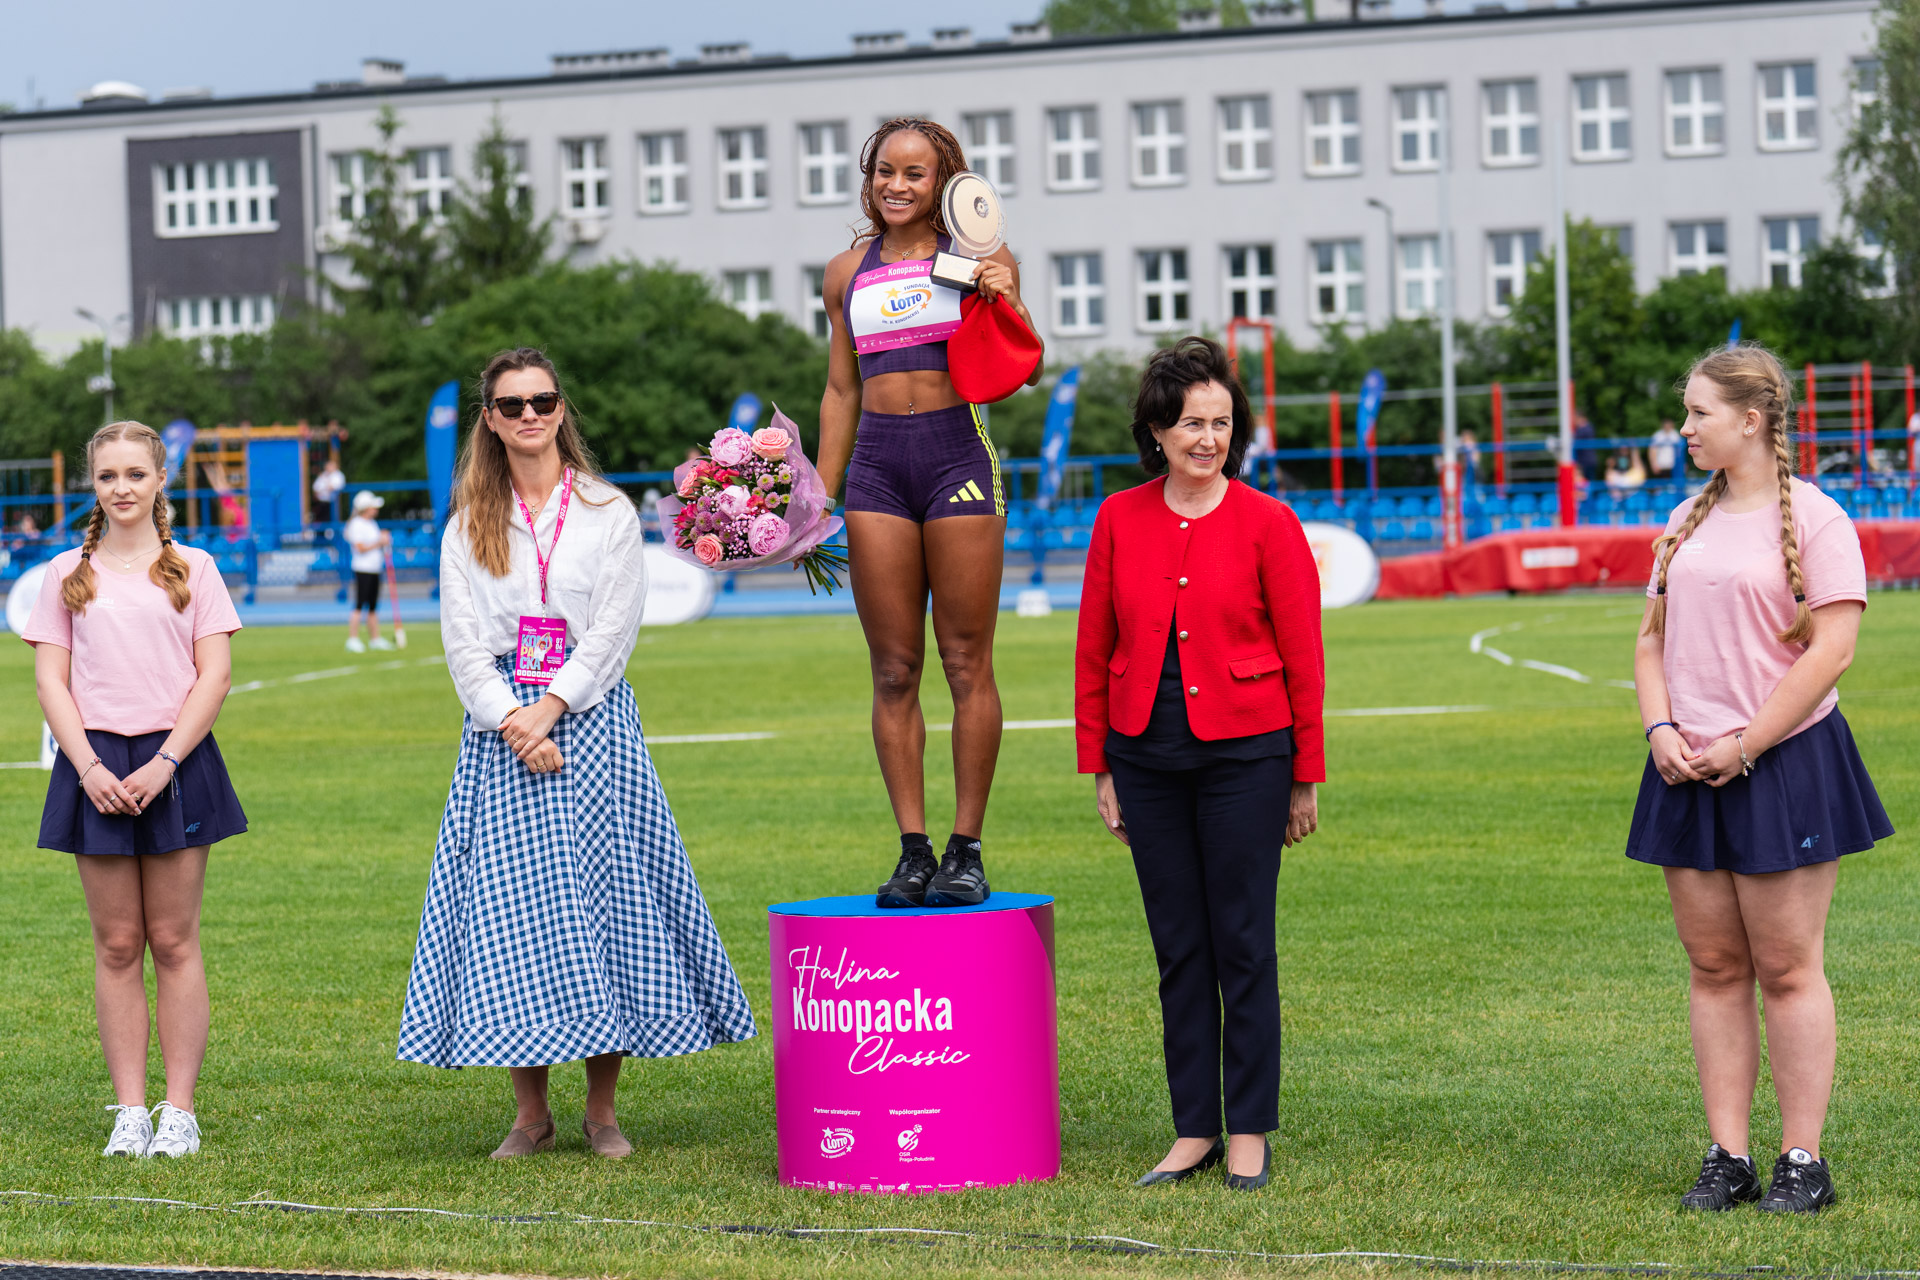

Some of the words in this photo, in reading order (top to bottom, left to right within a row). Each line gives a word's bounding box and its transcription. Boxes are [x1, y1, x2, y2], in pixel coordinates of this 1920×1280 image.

[887, 264, 925, 277] Konopacka
[903, 283, 930, 291] FUNDACJA
[890, 293, 922, 312] LOTTO
[559, 504, 567, 520] 2026
[520, 646, 534, 657] PA
[520, 656, 540, 670] CKA
[788, 945, 900, 999] Halina
[793, 987, 953, 1043] Konopacka
[848, 1035, 971, 1075] Classic
[888, 1108, 941, 1116] Współorganizator
[826, 1136, 848, 1150] LOTTO
